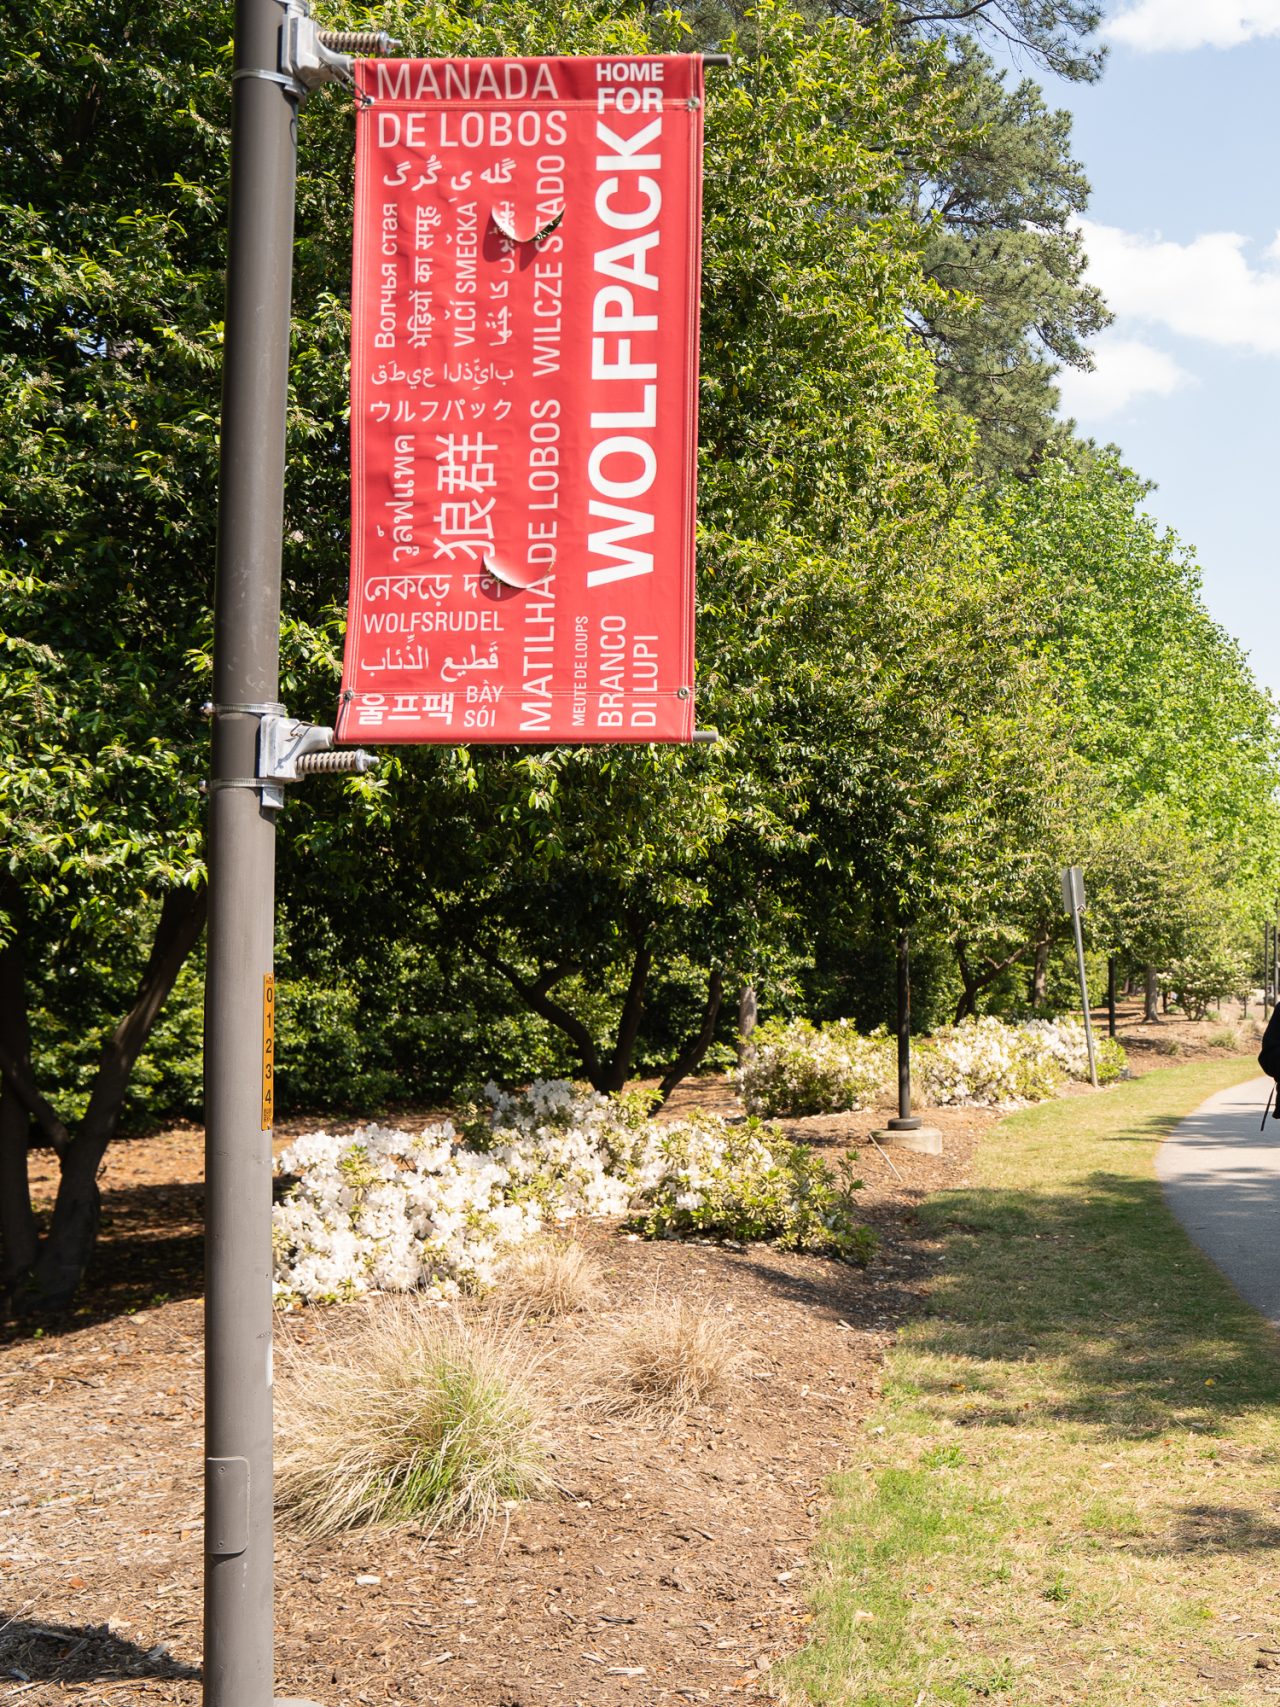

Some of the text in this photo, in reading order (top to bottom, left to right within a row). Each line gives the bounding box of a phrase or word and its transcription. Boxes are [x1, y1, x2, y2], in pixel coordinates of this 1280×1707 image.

[376, 63, 559, 99] MANADA
[596, 62, 664, 82] HOME
[597, 87, 664, 114] FOR
[378, 110, 567, 148] DE LOBOS
[415, 205, 442, 251] समूह
[374, 203, 398, 348] Волчья стая
[414, 256, 434, 284] का
[444, 199, 479, 348] VLČÍ SMEČKA
[532, 155, 566, 377] WILCZE STADO
[586, 117, 662, 588] WOLFPACK
[370, 398, 512, 423] ウルフパック
[377, 435, 420, 562] วูล์ฟแพค
[432, 432, 498, 560] 狼群
[519, 399, 561, 732] MATILHA DE LOBOS
[363, 611, 505, 634] WOLFSRUDEL
[571, 615, 589, 727] MEUTE DE LOUPS
[597, 614, 627, 727] BRANCO
[630, 634, 659, 727] DI LUPI
[355, 692, 455, 726] 울프팩
[463, 705, 497, 728] SÓI
